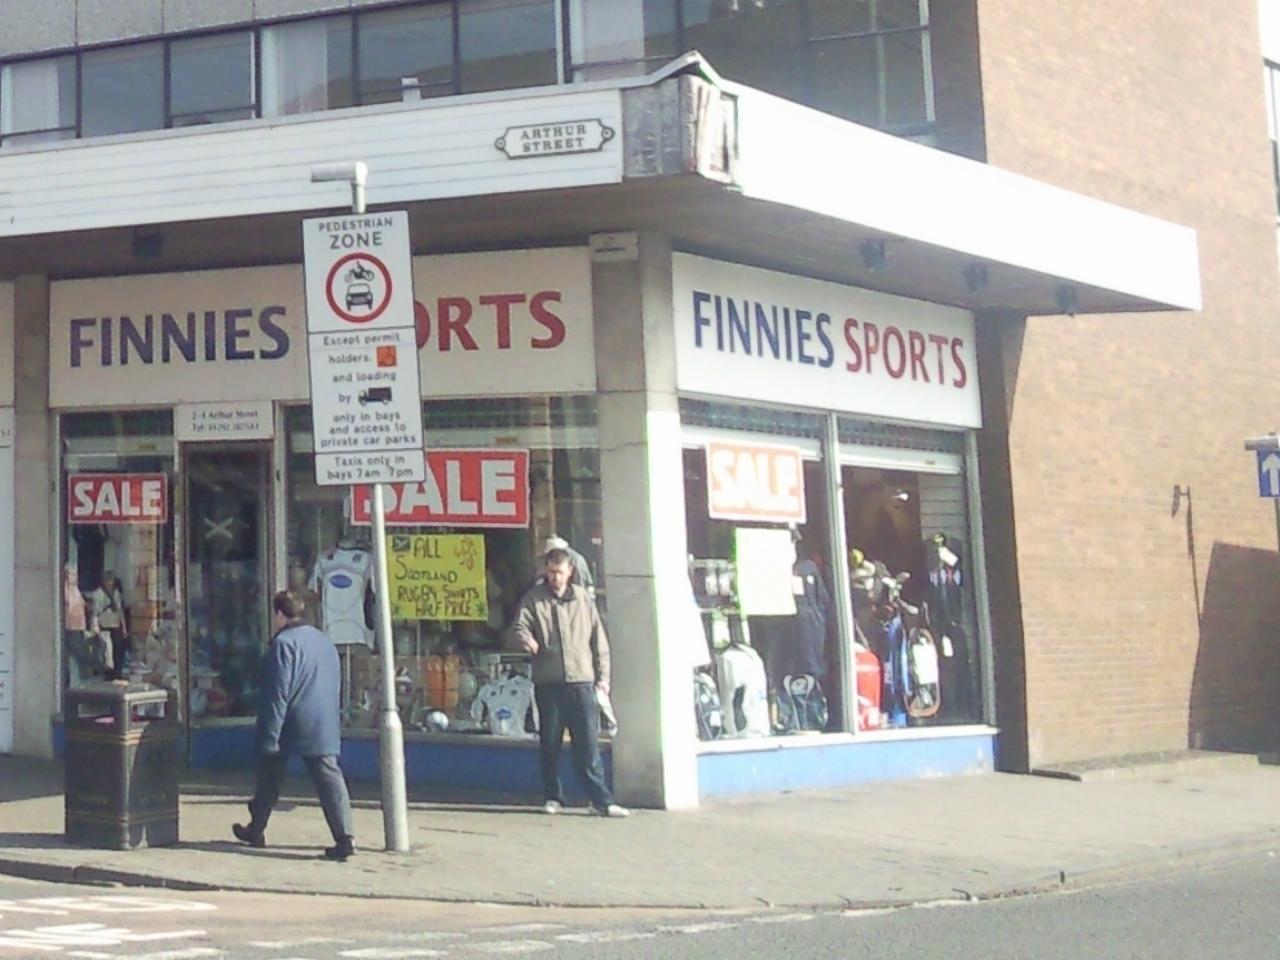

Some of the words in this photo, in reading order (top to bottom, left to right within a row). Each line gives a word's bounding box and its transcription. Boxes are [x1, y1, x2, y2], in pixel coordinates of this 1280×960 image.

[520, 124, 587, 140] ARTHUR
[522, 137, 585, 153] STREET
[318, 217, 393, 232] PEDESTRIAN
[329, 231, 383, 250] ZONE
[70, 306, 291, 367] FINNIES
[414, 290, 567, 352] RTS
[323, 335, 361, 347] Except
[364, 332, 401, 345] permit
[692, 290, 835, 369] FINNIES
[843, 318, 967, 389] SPORTS
[332, 373, 352, 383] and
[357, 371, 397, 383] loading
[338, 393, 351, 404] by
[333, 413, 356, 423] only
[360, 412, 370, 420] in
[375, 411, 401, 422] bays
[329, 424, 349, 434] and
[353, 424, 390, 433] access
[395, 422, 406, 432] to
[321, 436, 358, 449] private
[363, 436, 380, 444] car
[385, 434, 417, 446] parks
[334, 456, 363, 467] Taxis
[367, 455, 390, 467] only
[395, 454, 405, 464] in
[327, 469, 352, 481] bays
[712, 449, 799, 512] SALE
[73, 480, 162, 517] SALE
[413, 537, 442, 559] ALL
